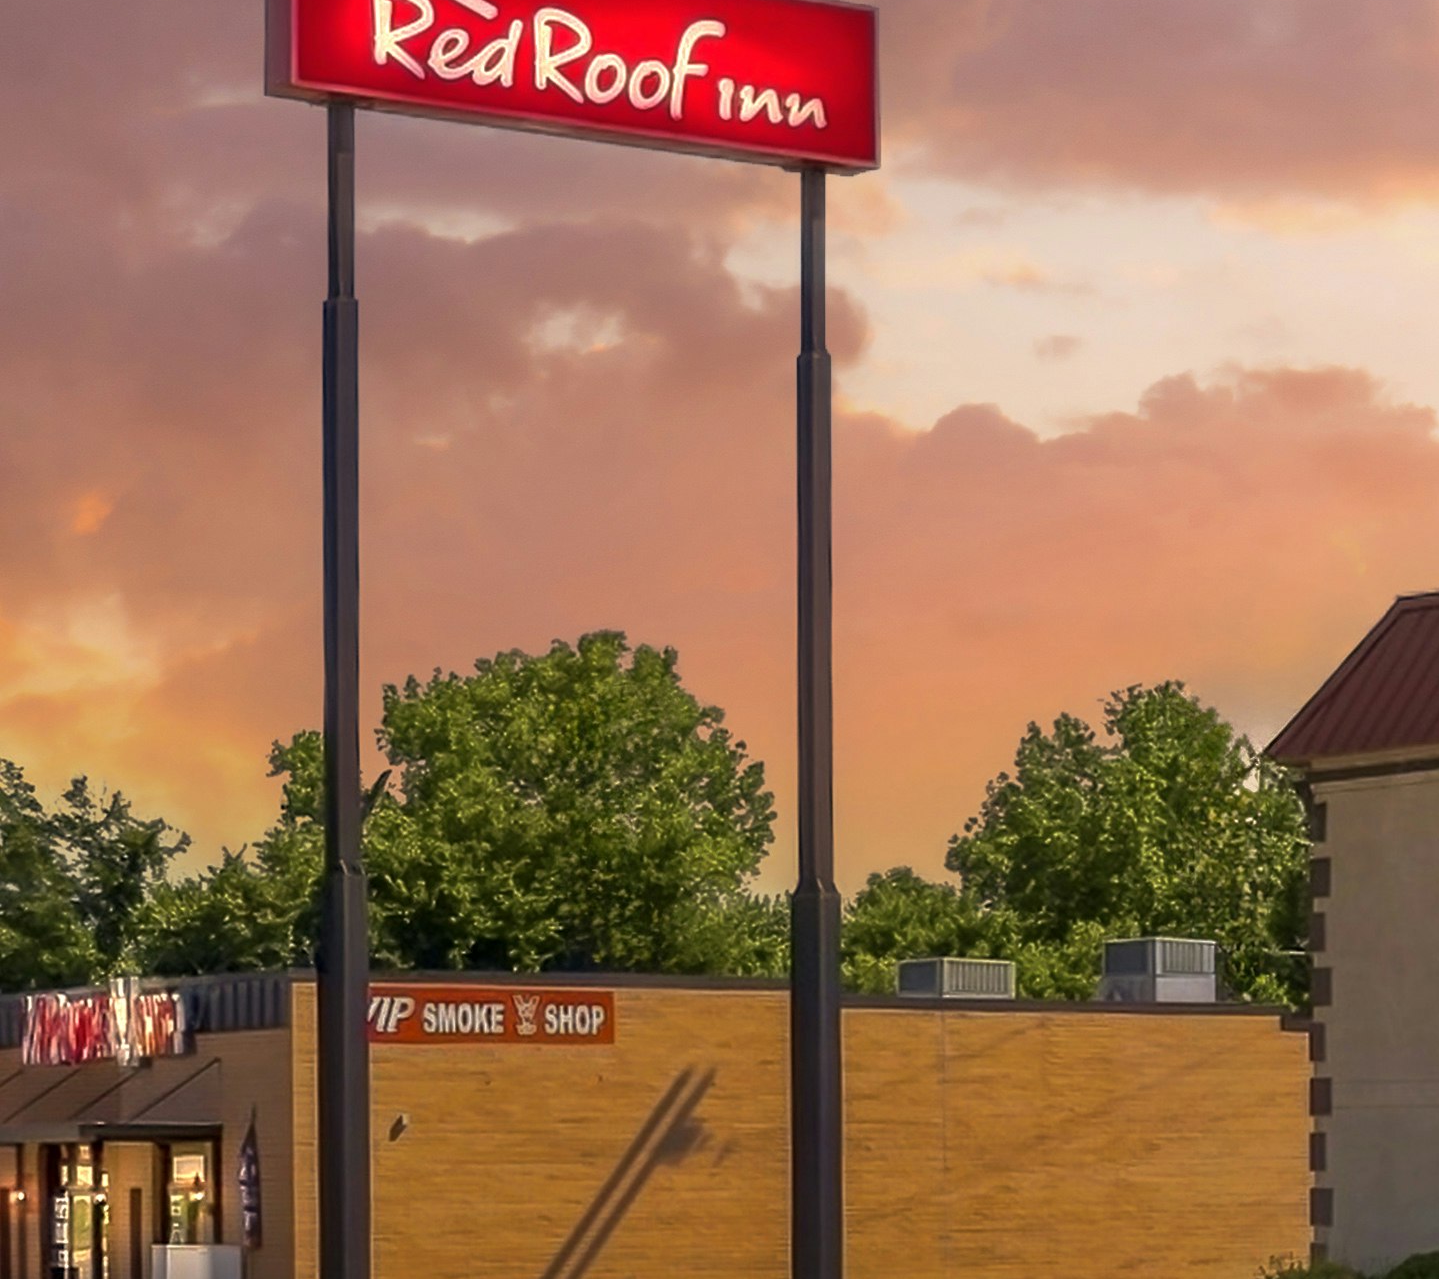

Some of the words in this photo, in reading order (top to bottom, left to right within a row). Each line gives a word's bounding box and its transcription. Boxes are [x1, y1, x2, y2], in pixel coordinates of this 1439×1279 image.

[533, 7, 727, 121] Roof
[422, 1002, 505, 1034] SMOKE
[544, 1003, 606, 1036] SHOP
